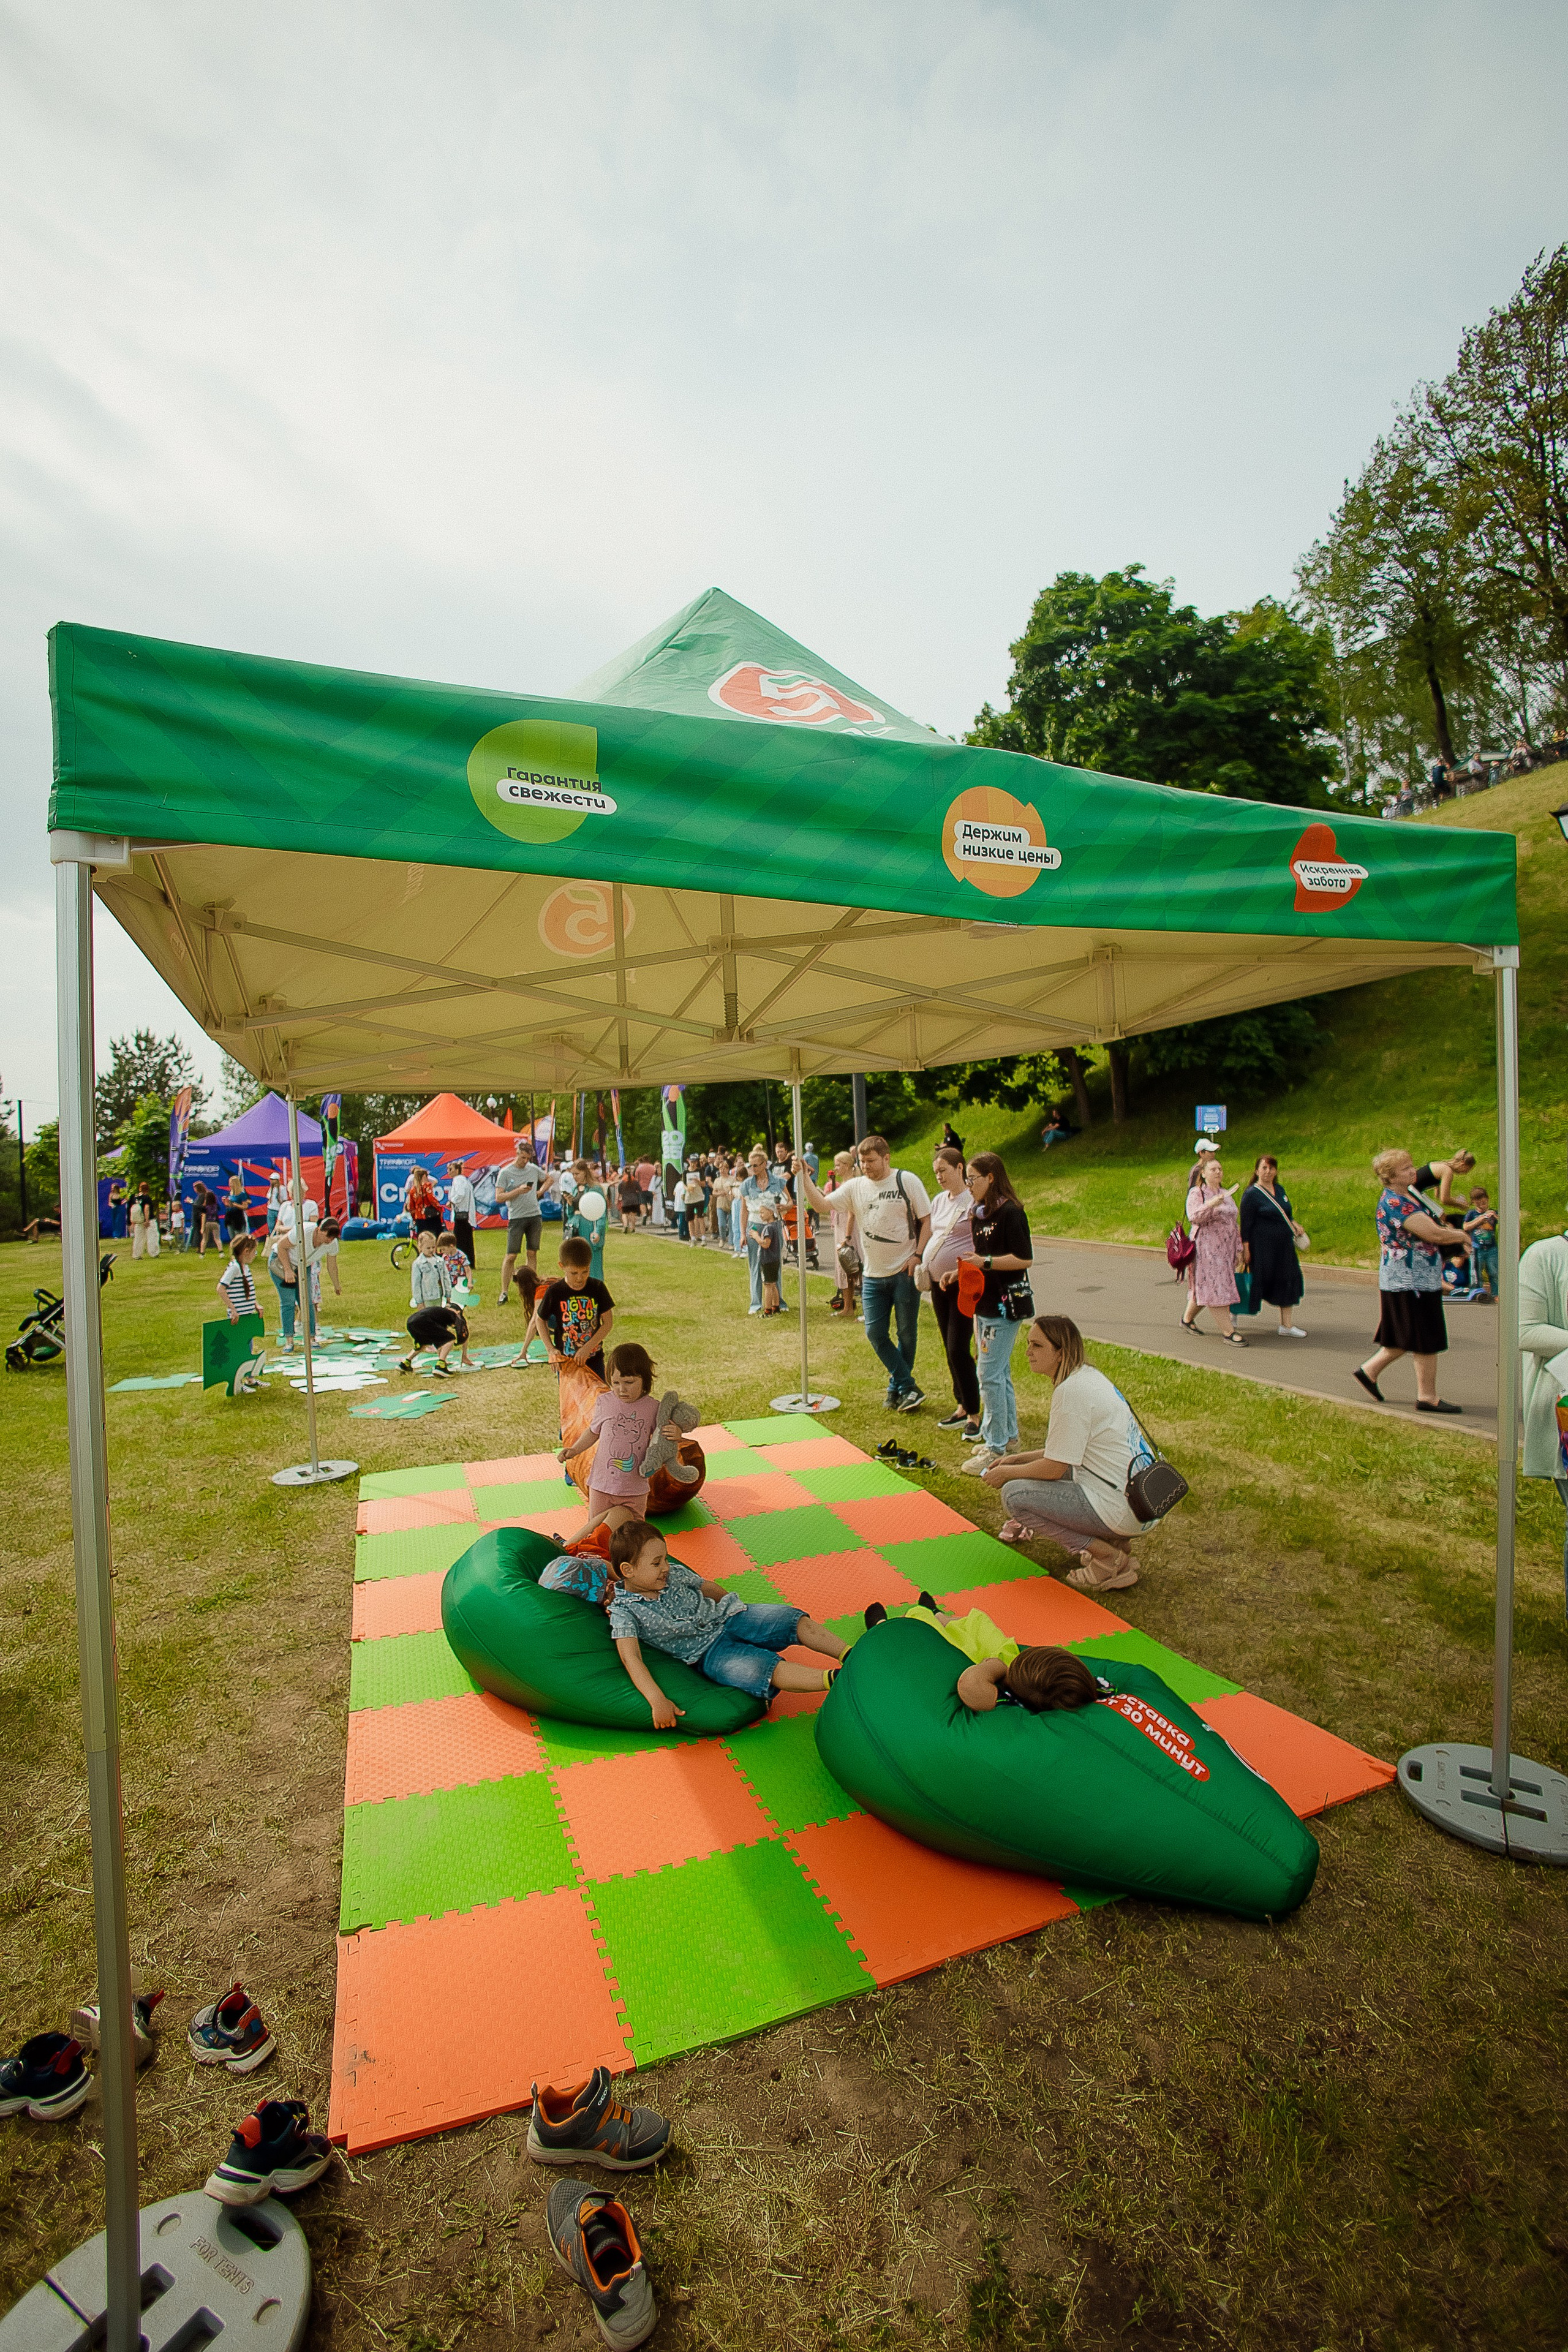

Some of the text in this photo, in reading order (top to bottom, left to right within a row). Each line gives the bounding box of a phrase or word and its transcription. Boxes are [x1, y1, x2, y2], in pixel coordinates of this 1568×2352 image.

[507, 766, 602, 793] Гарантия
[508, 785, 606, 809] свежести
[962, 824, 1022, 843] Держим
[962, 844, 1054, 865] низкие цены
[1299, 864, 1362, 876] Искренняя
[1307, 876, 1346, 888] забота
[560, 1298, 598, 1312] DIGITAL
[1111, 1694, 1190, 1747] оставка
[1120, 1703, 1144, 1724] 30
[1145, 1723, 1206, 1776] минут
[188, 2236, 219, 2264] FOR
